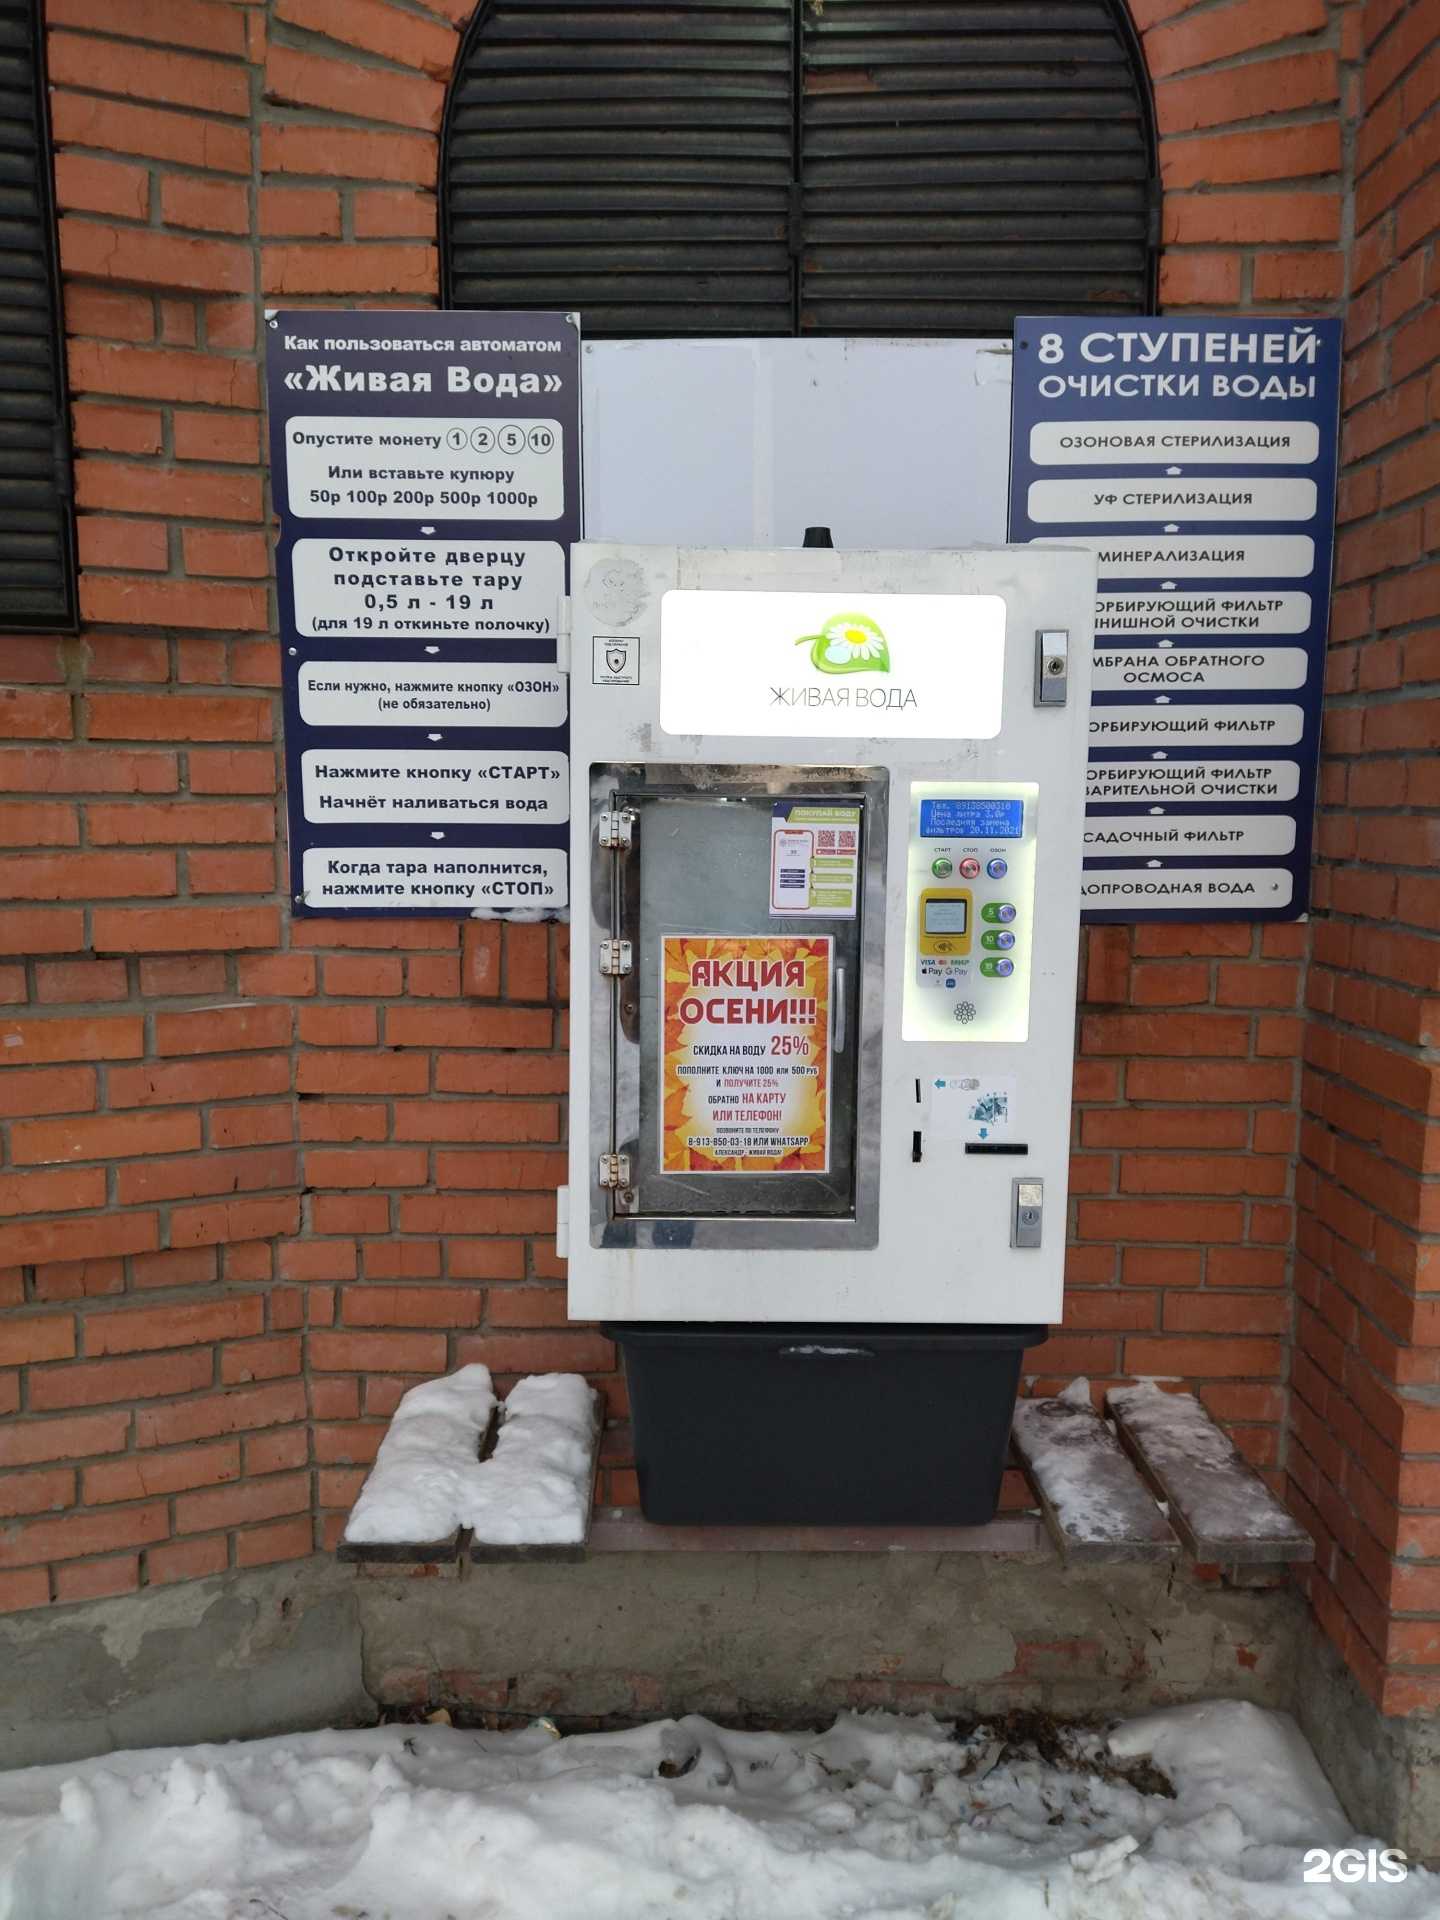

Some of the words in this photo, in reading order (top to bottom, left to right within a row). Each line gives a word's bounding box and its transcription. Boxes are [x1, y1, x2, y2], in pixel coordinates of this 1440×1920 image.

[284, 336, 318, 350] Как
[325, 338, 454, 352] пользоваться
[460, 339, 561, 352] автоматом
[1038, 333, 1064, 364] 8
[1080, 326, 1316, 364] СТУПЕНЕЙ
[284, 365, 432, 392] «Живая
[448, 366, 563, 398] Вода»
[1038, 375, 1199, 398] ОЧИСТКИ
[1213, 375, 1316, 400] ВОДЫ
[292, 432, 373, 446] Опустите
[379, 434, 441, 449] монету
[531, 434, 551, 447] 10
[1060, 436, 1155, 448] ОЗОНОВАЯ
[1161, 435, 1290, 449] СТЕРИЛИЗАЦИЯ
[328, 466, 363, 479] Или
[369, 468, 444, 480] вставьте
[450, 469, 515, 483] купюру
[310, 490, 340, 505] 50р
[347, 490, 387, 506] 100р
[393, 491, 434, 506] 200р
[440, 492, 481, 506] 500р
[488, 492, 538, 507] 1000р
[1094, 494, 1118, 505] УФ
[1123, 493, 1252, 505] СТЕРИЛИЗАЦИЯ
[329, 547, 436, 566] Откройте
[445, 551, 526, 567] дверцу
[1098, 550, 1245, 563] МИНЕРАЛИЗАЦИЯ
[334, 574, 463, 588] подставьте
[472, 575, 523, 590] тару
[365, 594, 398, 611] 0,5
[408, 597, 421, 609] л
[446, 595, 471, 610] 19
[480, 597, 493, 610] л
[1221, 600, 1283, 611] ФИЛЬТР
[312, 617, 347, 631] (для
[354, 618, 373, 630] 19
[378, 620, 389, 630] л
[394, 619, 469, 631] откиньте
[475, 618, 550, 633] полочку)
[1095, 614, 1175, 629] НИШНОЙ
[1181, 617, 1259, 628] ОЧИСТКИ
[1165, 655, 1264, 666] ОБРАТНОГО
[1124, 672, 1205, 683] ОСМОСА
[308, 680, 340, 692] Если
[345, 682, 391, 693] нужно,
[395, 682, 453, 692] нажмите
[458, 682, 503, 695] кнопку
[507, 682, 559, 693] «ОЗОН»
[378, 698, 399, 711] (не
[403, 699, 491, 712] обязательно)
[769, 686, 850, 707] ЖИВАЯ
[856, 687, 918, 711] ВОДА
[1214, 721, 1275, 731] ФИЛЬТР
[315, 765, 400, 778] Нажмите
[406, 767, 471, 782] кнопку
[478, 766, 560, 780] «СТАРТ»
[1211, 768, 1272, 779] ФИЛЬТР
[1201, 784, 1278, 795] ОЧИСТКИ
[319, 795, 386, 809] Начнёт
[392, 797, 499, 809] наливаться
[505, 799, 548, 811] вода
[1184, 831, 1244, 841] ФИЛЬТР
[328, 861, 381, 876] Когда
[387, 863, 427, 877] тара
[433, 863, 548, 877] наполнится,
[322, 883, 404, 895] нажмите
[411, 884, 475, 897] кнопку
[481, 882, 553, 895] «СТОП»
[1208, 883, 1255, 894] ВОДА
[692, 960, 805, 991] АКЦИЯ
[680, 998, 816, 1024] ОСЕНИ!!!
[693, 1045, 727, 1056] СКИДКА
[730, 1046, 740, 1054] НА
[743, 1046, 766, 1056] ВОДУ
[771, 1035, 809, 1055] 25%
[678, 1066, 719, 1074] ПОПОЛНИТЕ
[722, 1066, 743, 1074] КЛЮЧ
[745, 1066, 754, 1074] НА
[757, 1066, 773, 1074] 1000
[792, 1066, 805, 1074] 500
[724, 1079, 761, 1087] ПОЛУЧИТЕ
[708, 1096, 739, 1104] ОБРАТНО
[742, 1094, 755, 1103] НА
[757, 1093, 786, 1103] КАРТУ
[713, 1111, 732, 1121] ИЛИ
[735, 1110, 782, 1121] ТЕЛЕФОН!
[771, 1138, 808, 1146] WHATSAPP
